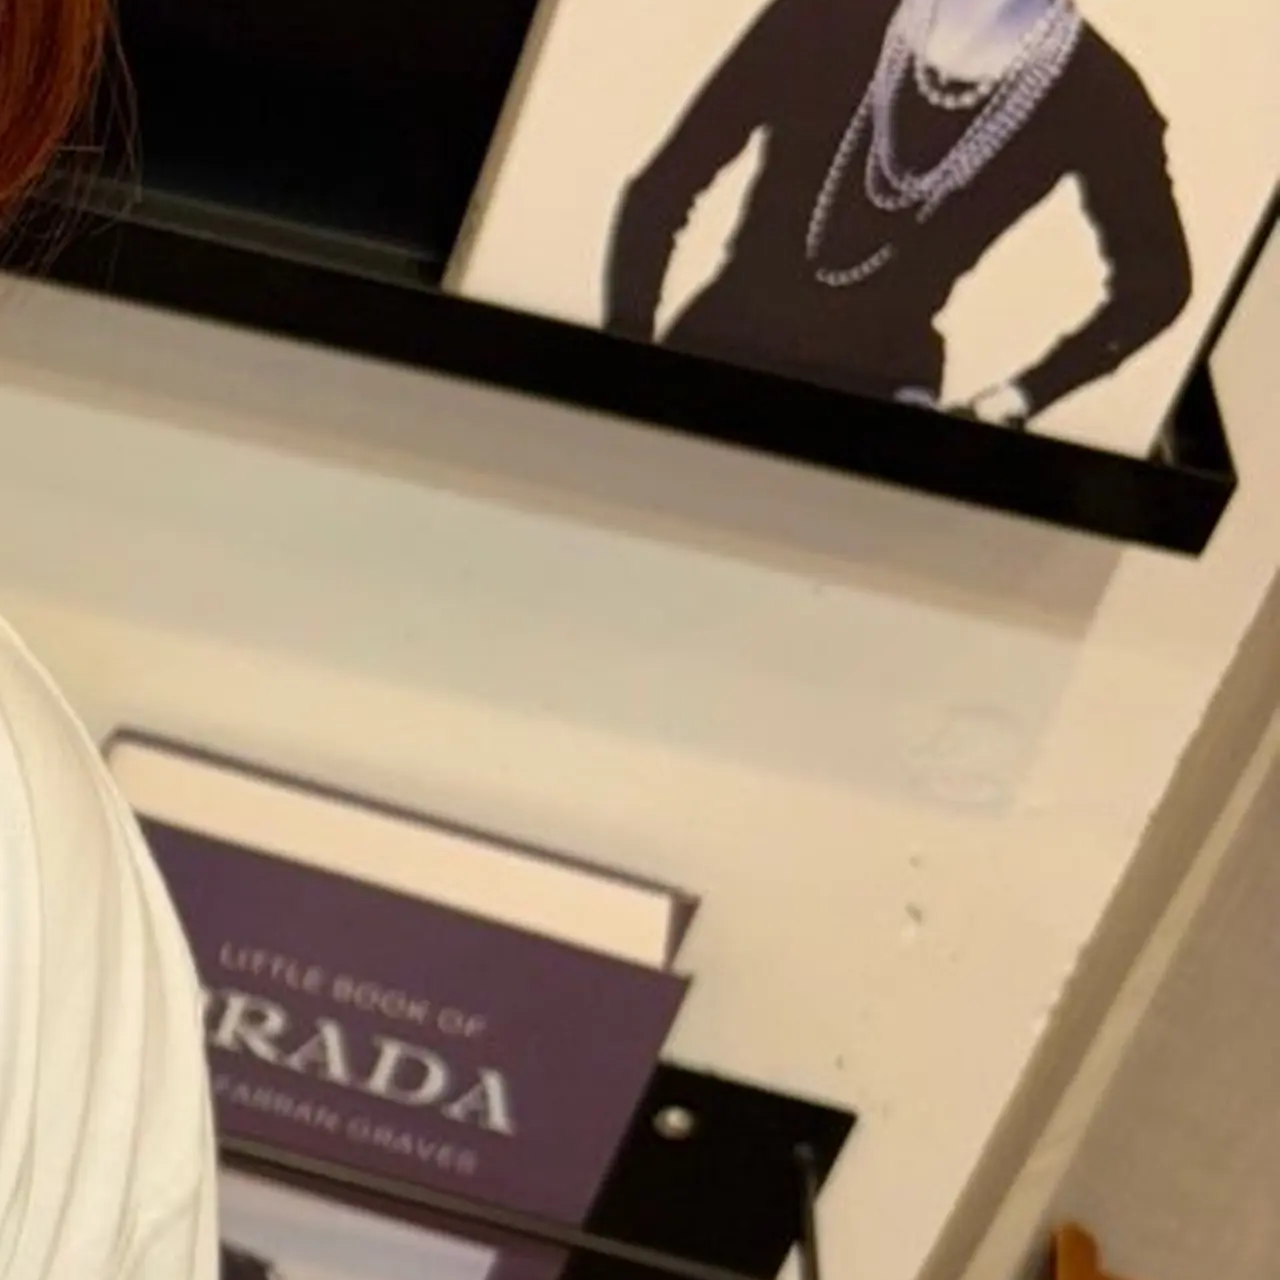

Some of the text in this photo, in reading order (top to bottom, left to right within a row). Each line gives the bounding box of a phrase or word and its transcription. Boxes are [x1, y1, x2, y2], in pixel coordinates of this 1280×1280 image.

[220, 940, 486, 1037] LITTLE BOOK OF
[200, 988, 516, 1136] RADA
